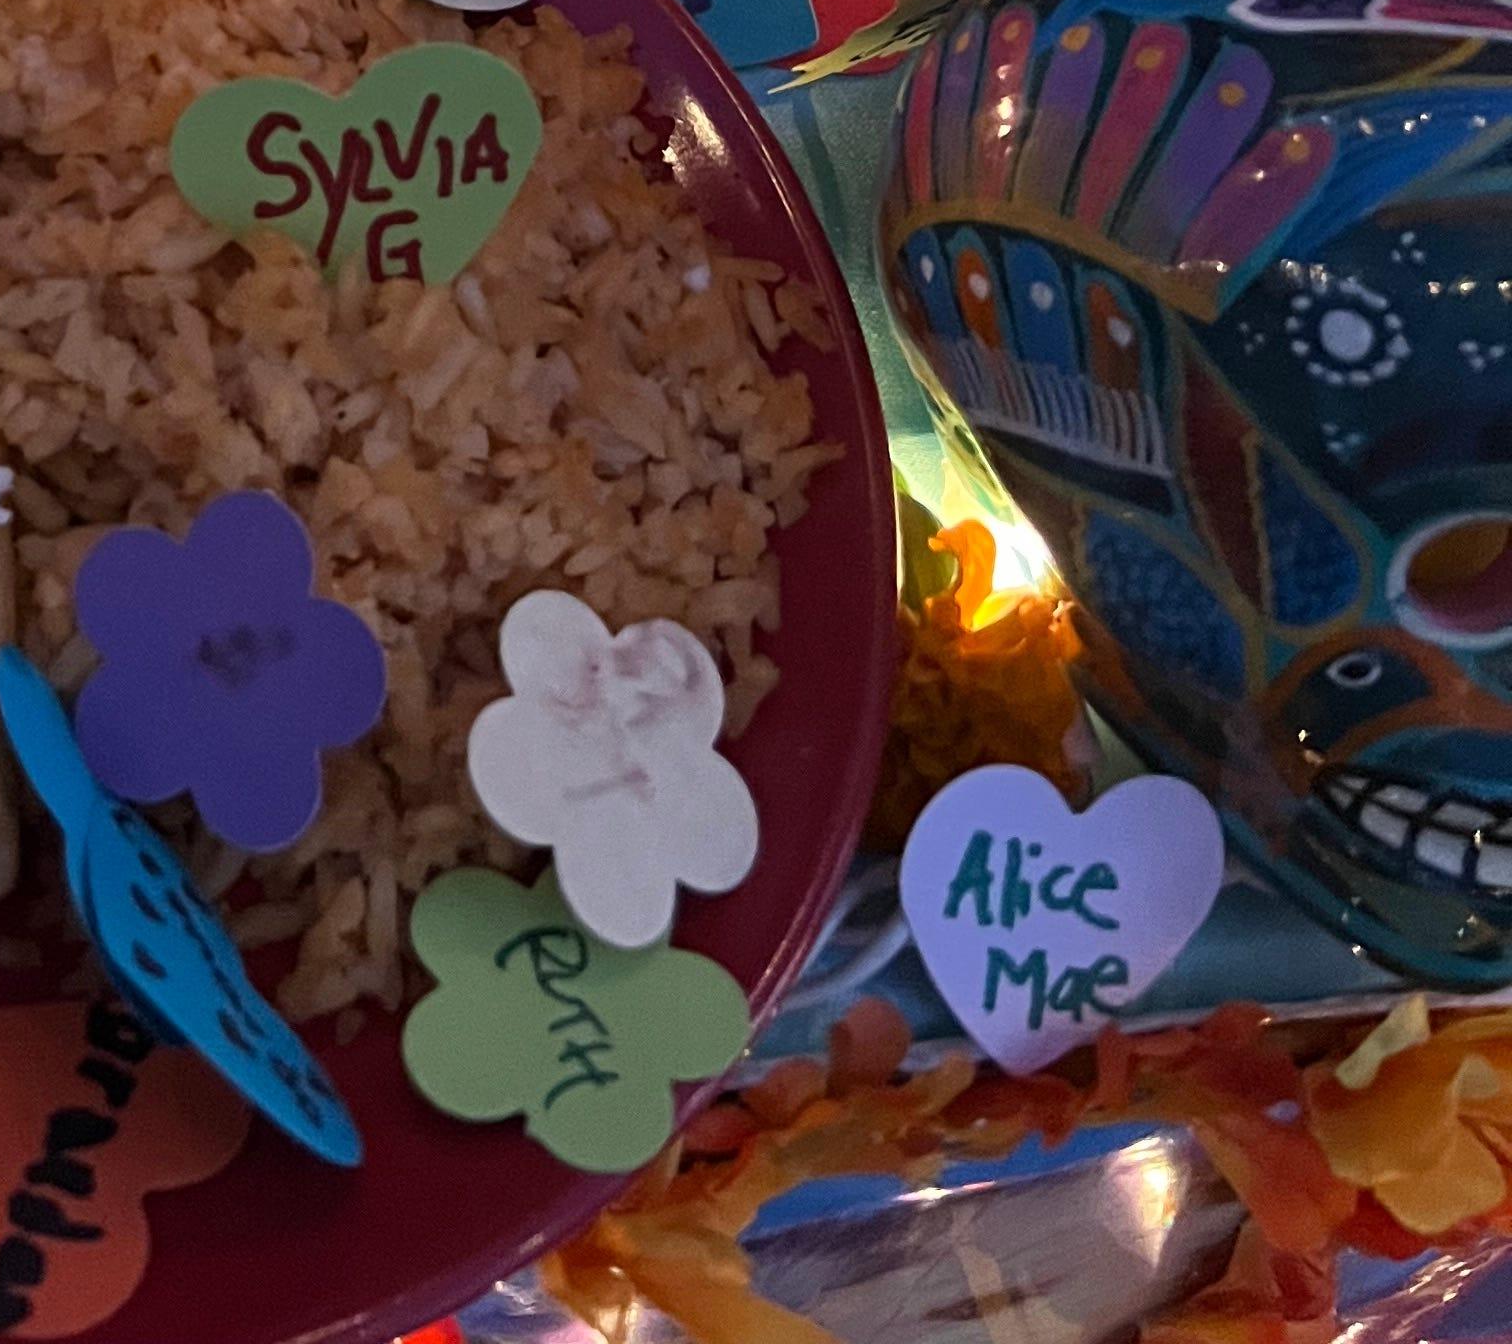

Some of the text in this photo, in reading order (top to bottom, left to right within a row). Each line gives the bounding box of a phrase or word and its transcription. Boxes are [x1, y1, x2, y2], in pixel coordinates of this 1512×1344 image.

[246, 93, 509, 266] SYLVIA
[366, 209, 423, 283] G
[942, 828, 1122, 933] Alice
[981, 946, 1131, 1031] Mae
